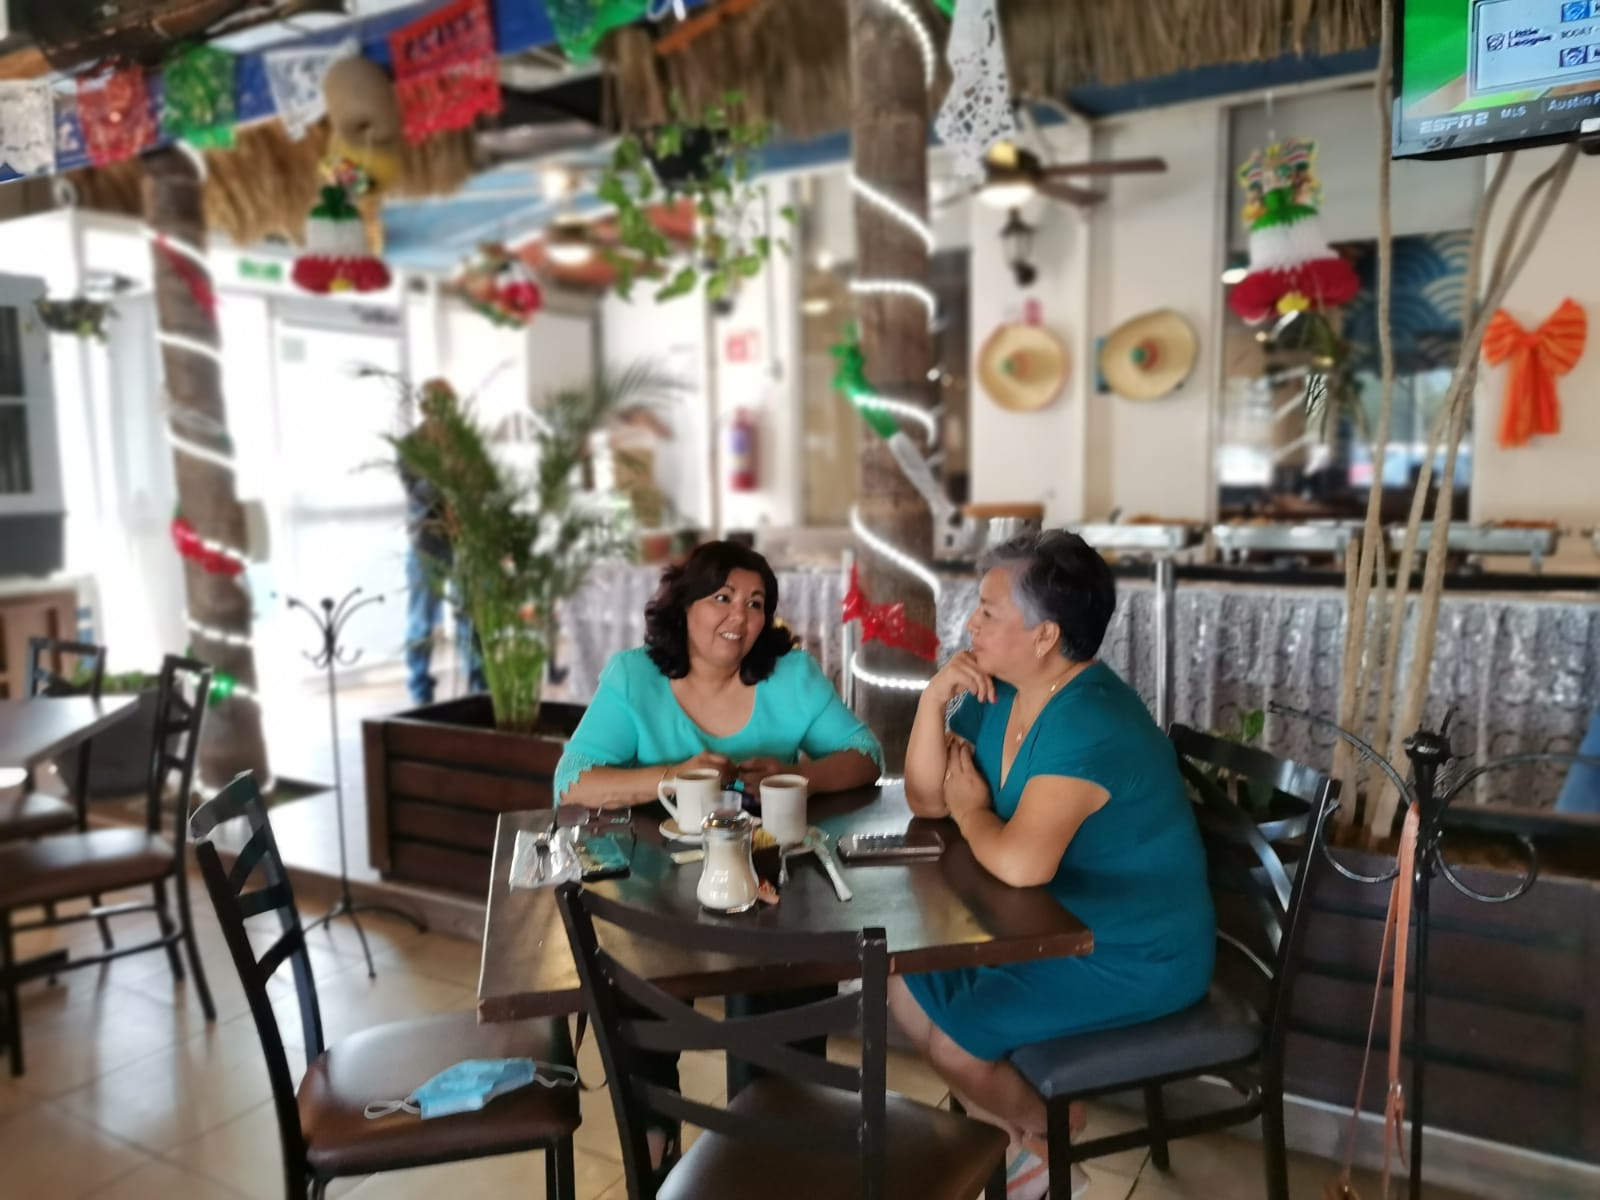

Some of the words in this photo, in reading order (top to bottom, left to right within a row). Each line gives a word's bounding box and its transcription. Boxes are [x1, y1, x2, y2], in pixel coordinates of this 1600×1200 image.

[1509, 28, 1538, 39] Little
[1508, 35, 1551, 48] League
[1547, 97, 1592, 112] Austin
[1420, 112, 1489, 134] ESPN2
